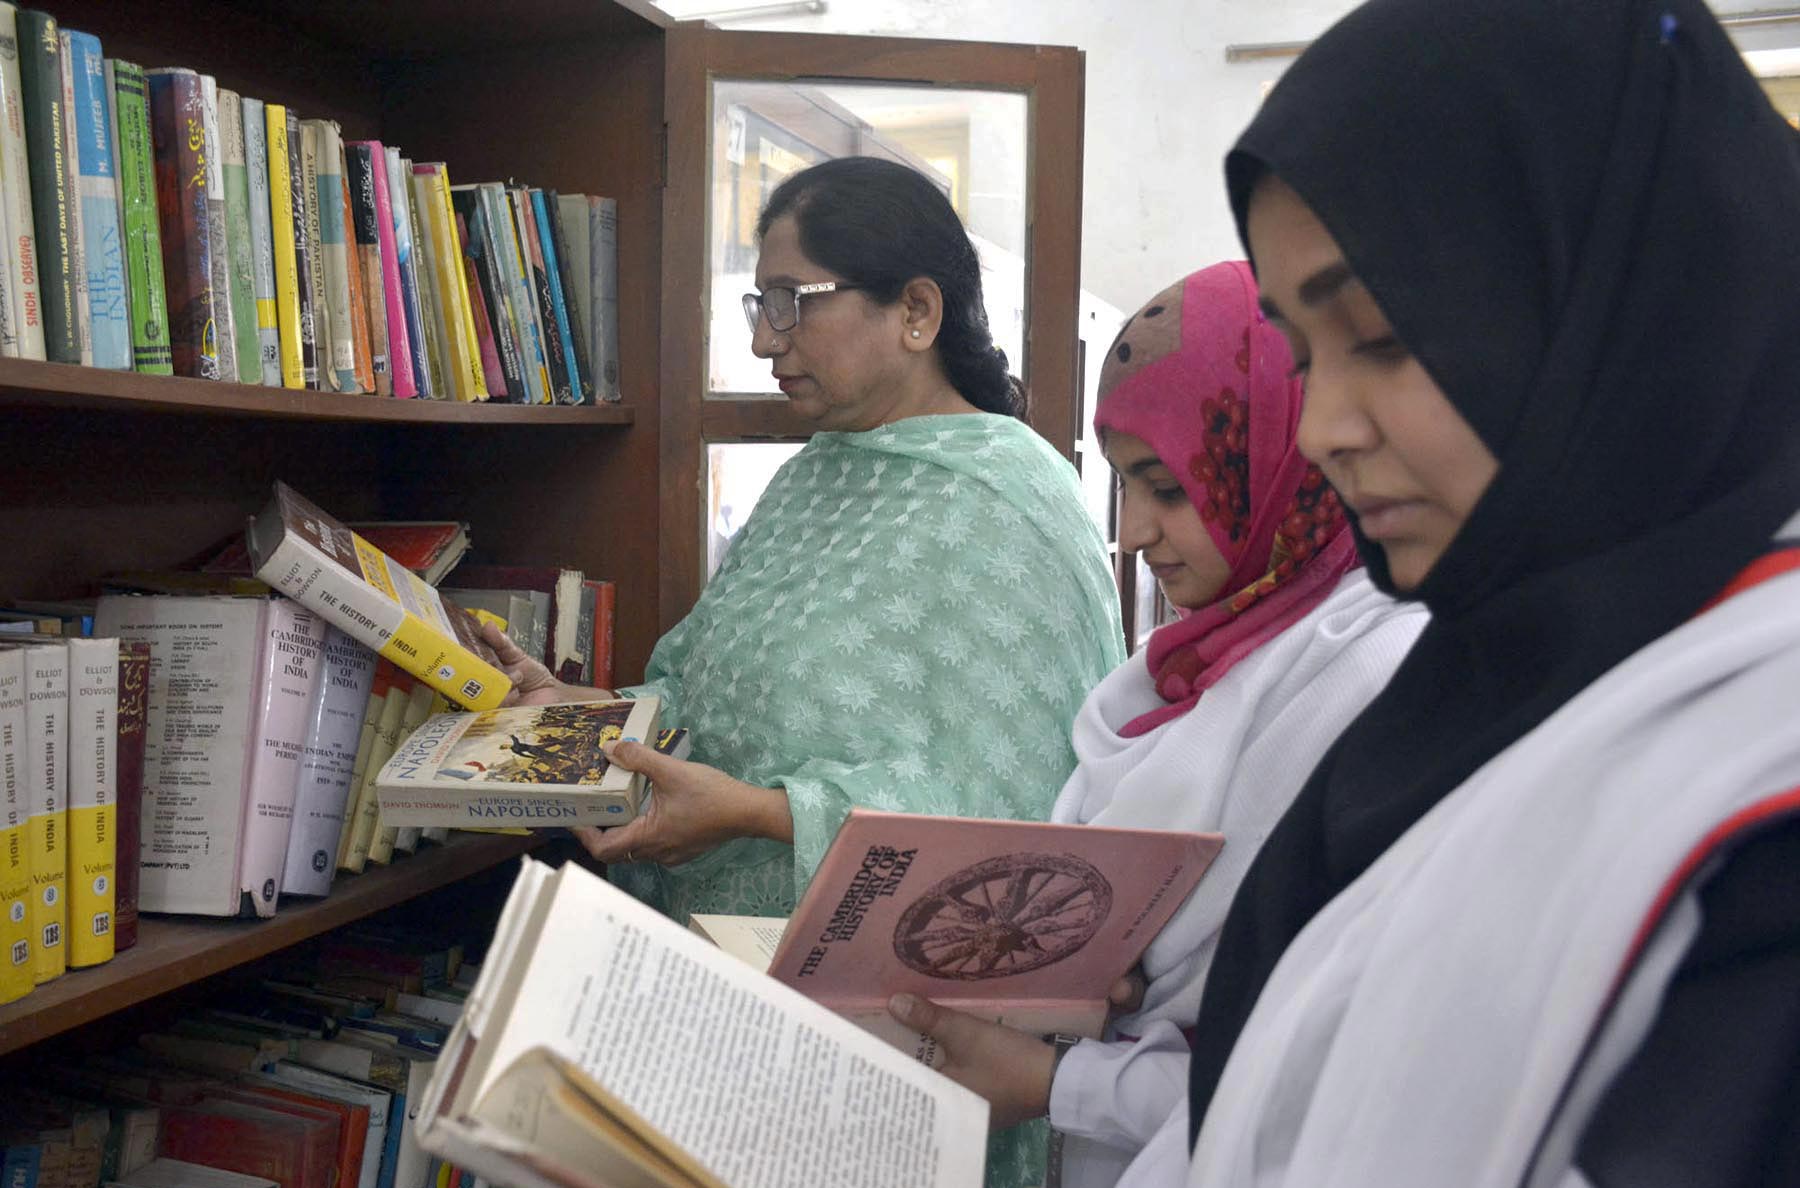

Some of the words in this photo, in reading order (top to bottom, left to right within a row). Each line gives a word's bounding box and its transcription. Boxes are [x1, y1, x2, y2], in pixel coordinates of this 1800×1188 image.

[51, 101, 61, 150] PAKISTAN
[306, 152, 313, 161] A
[54, 151, 64, 187] UNITED
[57, 187, 65, 202] OF
[306, 162, 318, 217] HISTORY
[58, 203, 66, 230] DAYS
[311, 218, 319, 236] OF
[60, 231, 68, 256] LAST
[19, 234, 34, 285] OBSERVED
[61, 256, 69, 274] THE
[312, 239, 323, 297] PAKISTAN
[103, 225, 124, 321] INDIAN
[88, 271, 108, 323] THE
[24, 291, 38, 327] SINDH
[280, 562, 301, 586] ELLIOT
[293, 623, 310, 636] THE
[320, 590, 338, 606] THE
[339, 603, 378, 631] HISTORY
[378, 628, 393, 640] OF
[393, 638, 418, 658] INDIA
[278, 641, 317, 659] HISTORY
[85, 666, 112, 675] ELLIOT
[292, 656, 304, 667] OF
[326, 654, 367, 671] HISTORY
[0, 676, 17, 687] LIOT
[36, 669, 62, 679] ELLIOT
[284, 665, 308, 679] INDIA
[340, 668, 353, 678] OF
[79, 687, 117, 697] DOWSON
[332, 677, 358, 691] INDIA
[0, 699, 24, 709] WSON
[30, 691, 67, 701] DOWSON
[45, 714, 55, 736] THE
[95, 709, 105, 731] THE
[4, 723, 13, 747] THE
[265, 738, 279, 748] THE
[45, 742, 55, 791] HISTORY
[95, 737, 105, 784] HISTORY
[5, 753, 17, 804] HISTORY
[46, 798, 55, 813] OF
[96, 791, 105, 806] OF
[383, 801, 412, 809] DAVID
[478, 797, 522, 806] EUROPE
[527, 799, 562, 807] SINCE
[8, 811, 18, 828] OF
[468, 805, 577, 818] NAPOLEON
[46, 819, 55, 853] INDIA
[96, 812, 105, 844] INDIA
[9, 833, 20, 868] INDIA
[880, 847, 918, 897] INDIA
[836, 873, 885, 941] HISTORY
[879, 846, 899, 869] OF
[798, 946, 828, 977] THE
[820, 845, 885, 943] CAMBRIDGE
